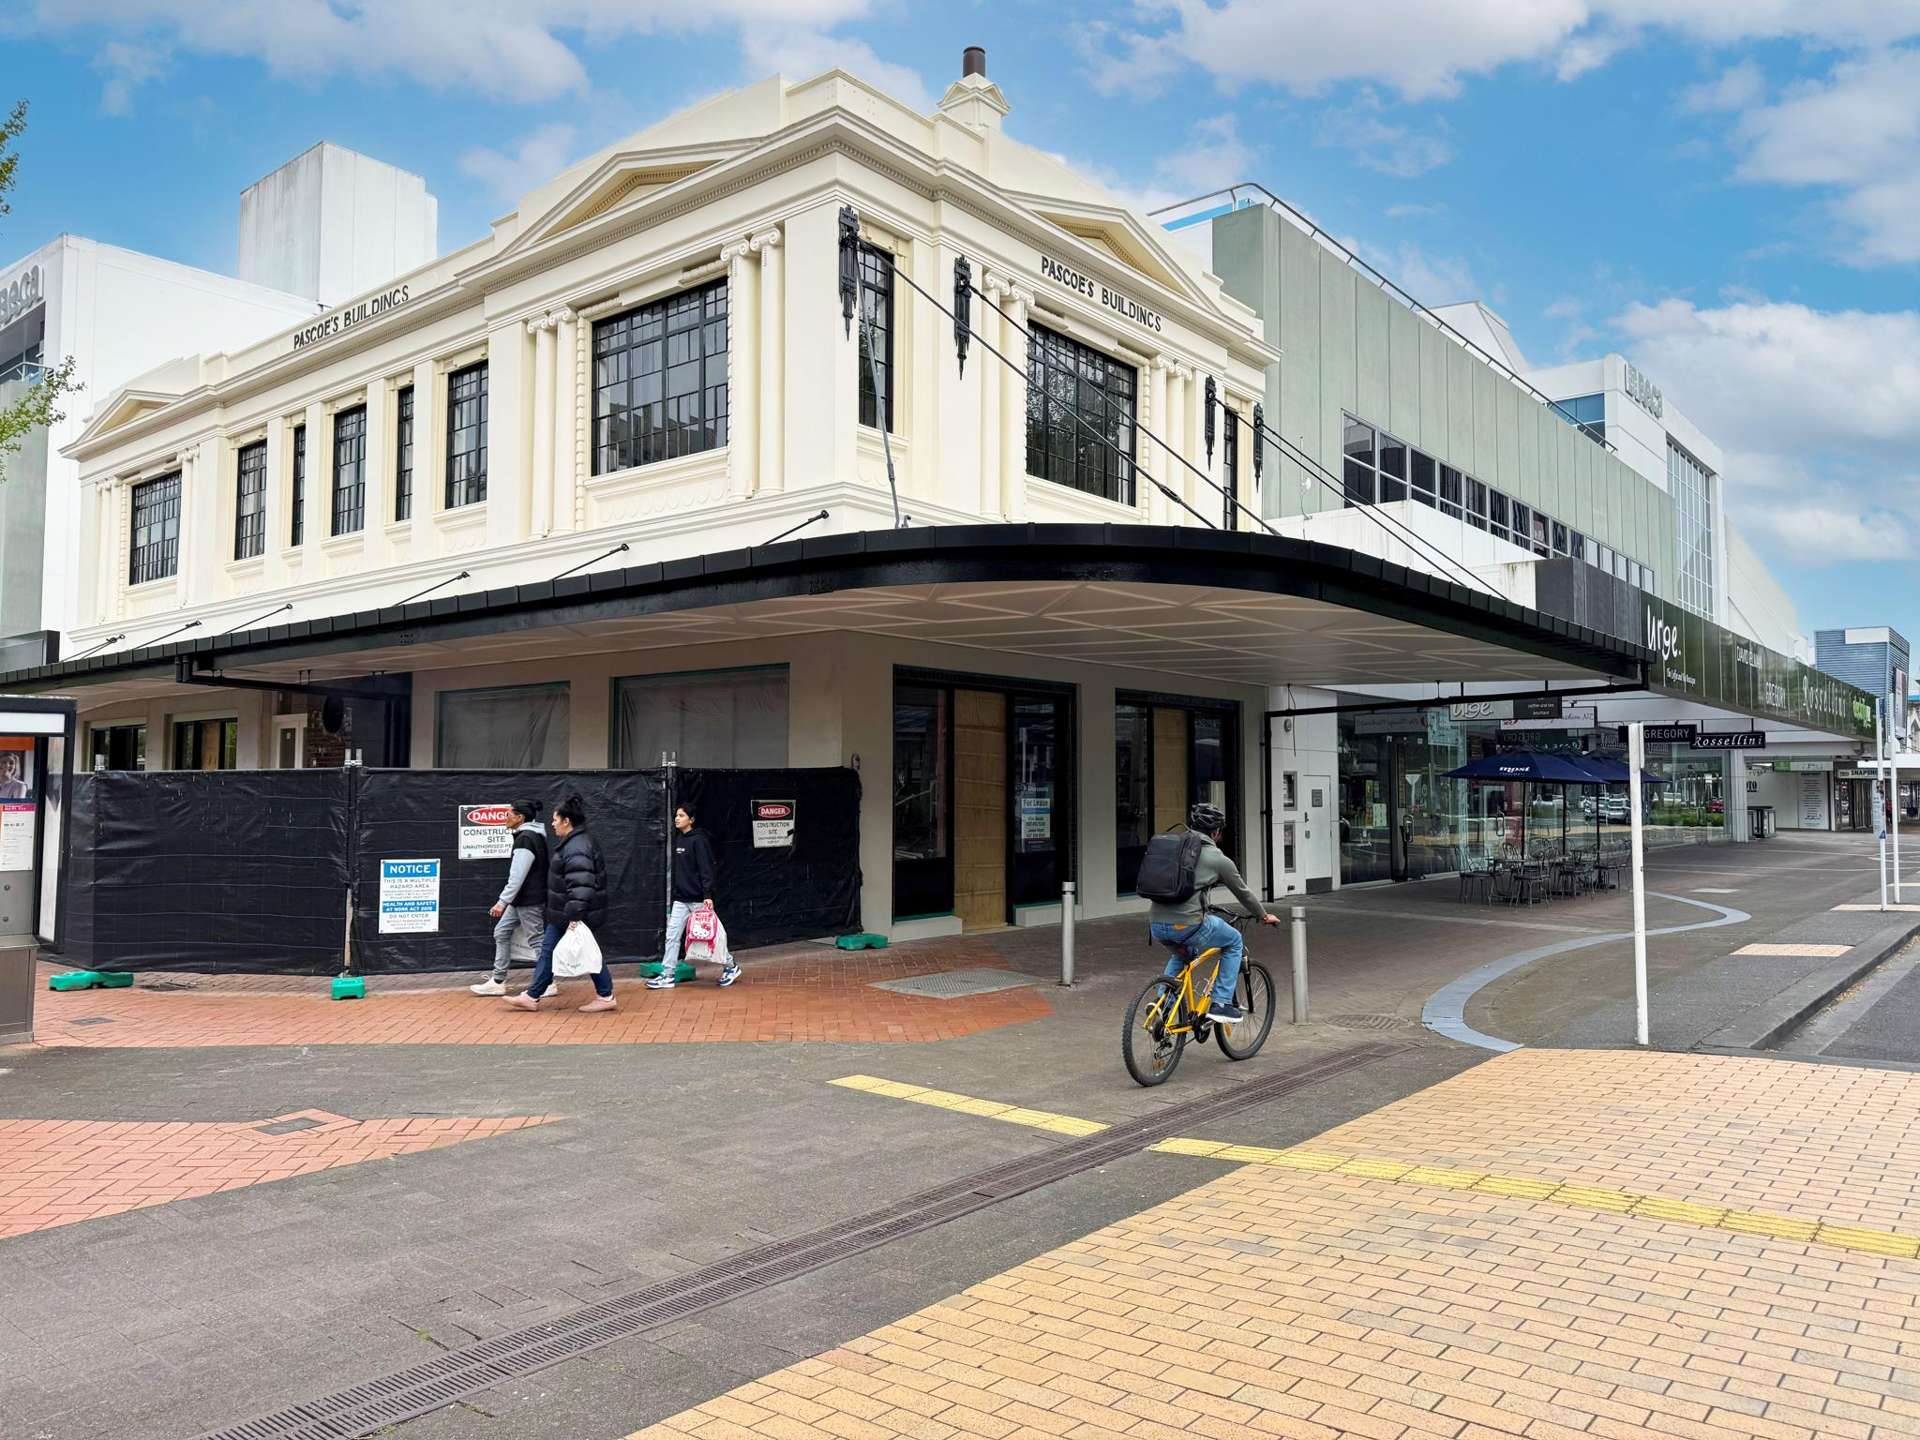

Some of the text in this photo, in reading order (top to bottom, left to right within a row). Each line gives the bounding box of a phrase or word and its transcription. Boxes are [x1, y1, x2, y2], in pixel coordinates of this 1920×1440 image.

[1041, 255, 1095, 298] PASCOE'S
[293, 316, 339, 349] PASCOE'S
[1643, 728, 1690, 740] GREGORY
[1693, 734, 1764, 747] Rossellini
[472, 811, 509, 821] DANG
[760, 807, 786, 816] DANGER
[389, 864, 432, 874] NOTICE
